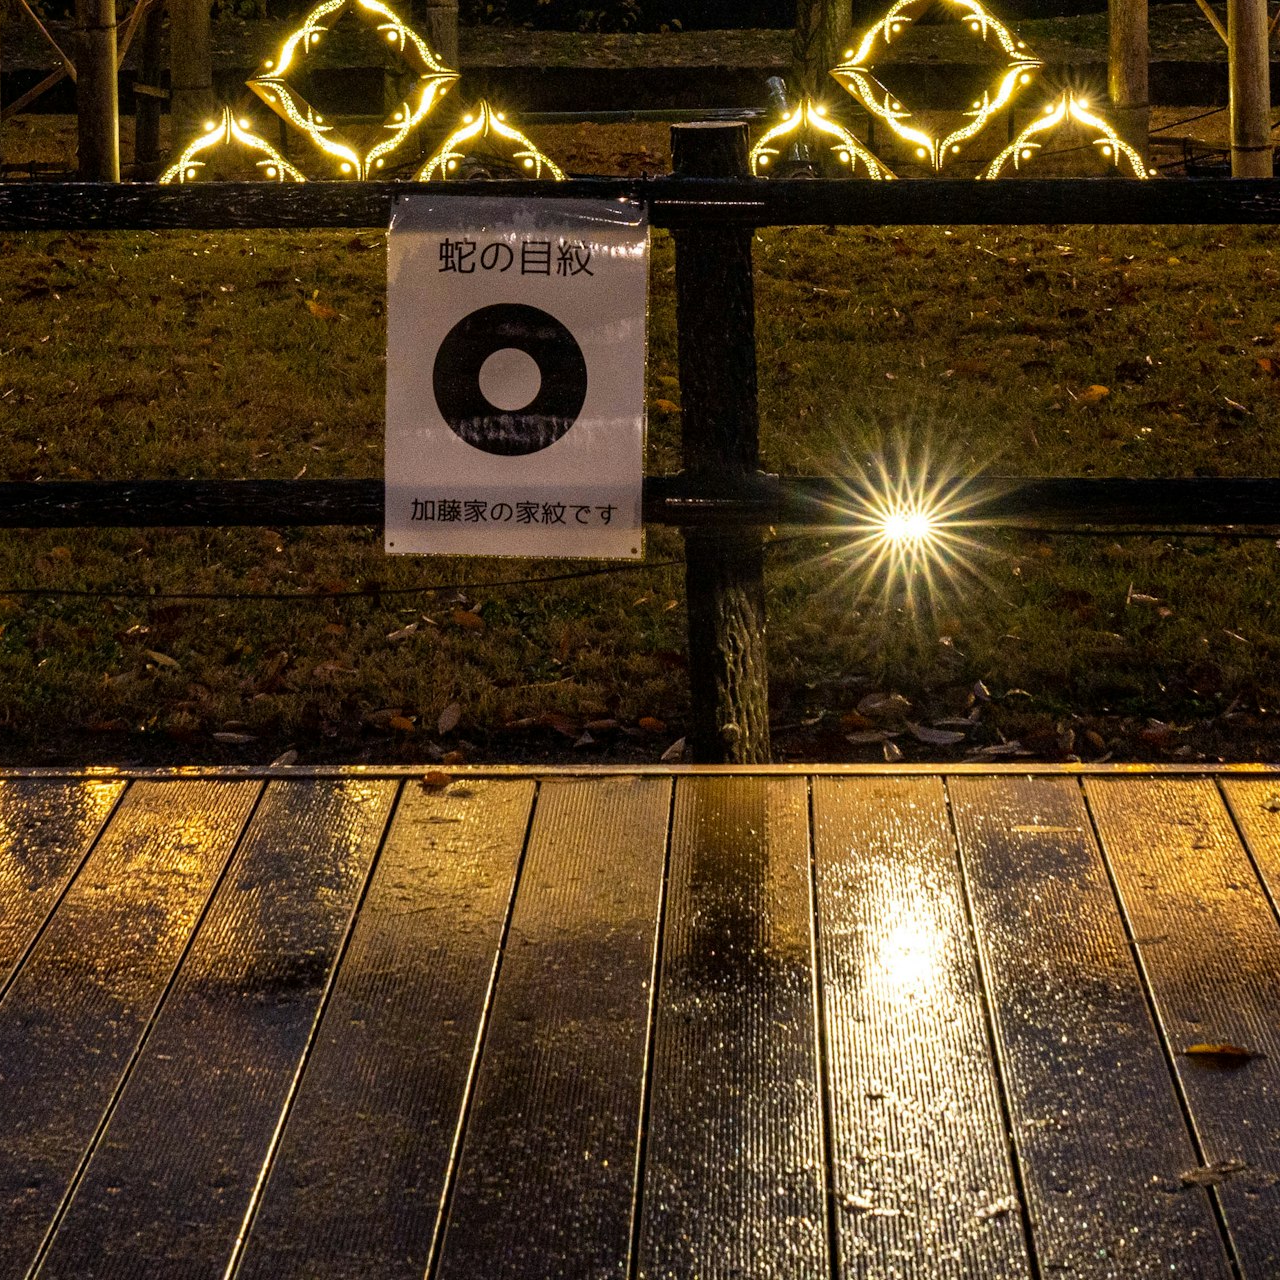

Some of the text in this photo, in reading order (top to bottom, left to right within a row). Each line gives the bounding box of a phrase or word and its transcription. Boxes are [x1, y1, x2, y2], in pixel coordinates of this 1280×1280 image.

[438, 237, 594, 277] 蛇の目紋
[411, 498, 618, 525] 加藤家の家紋です
